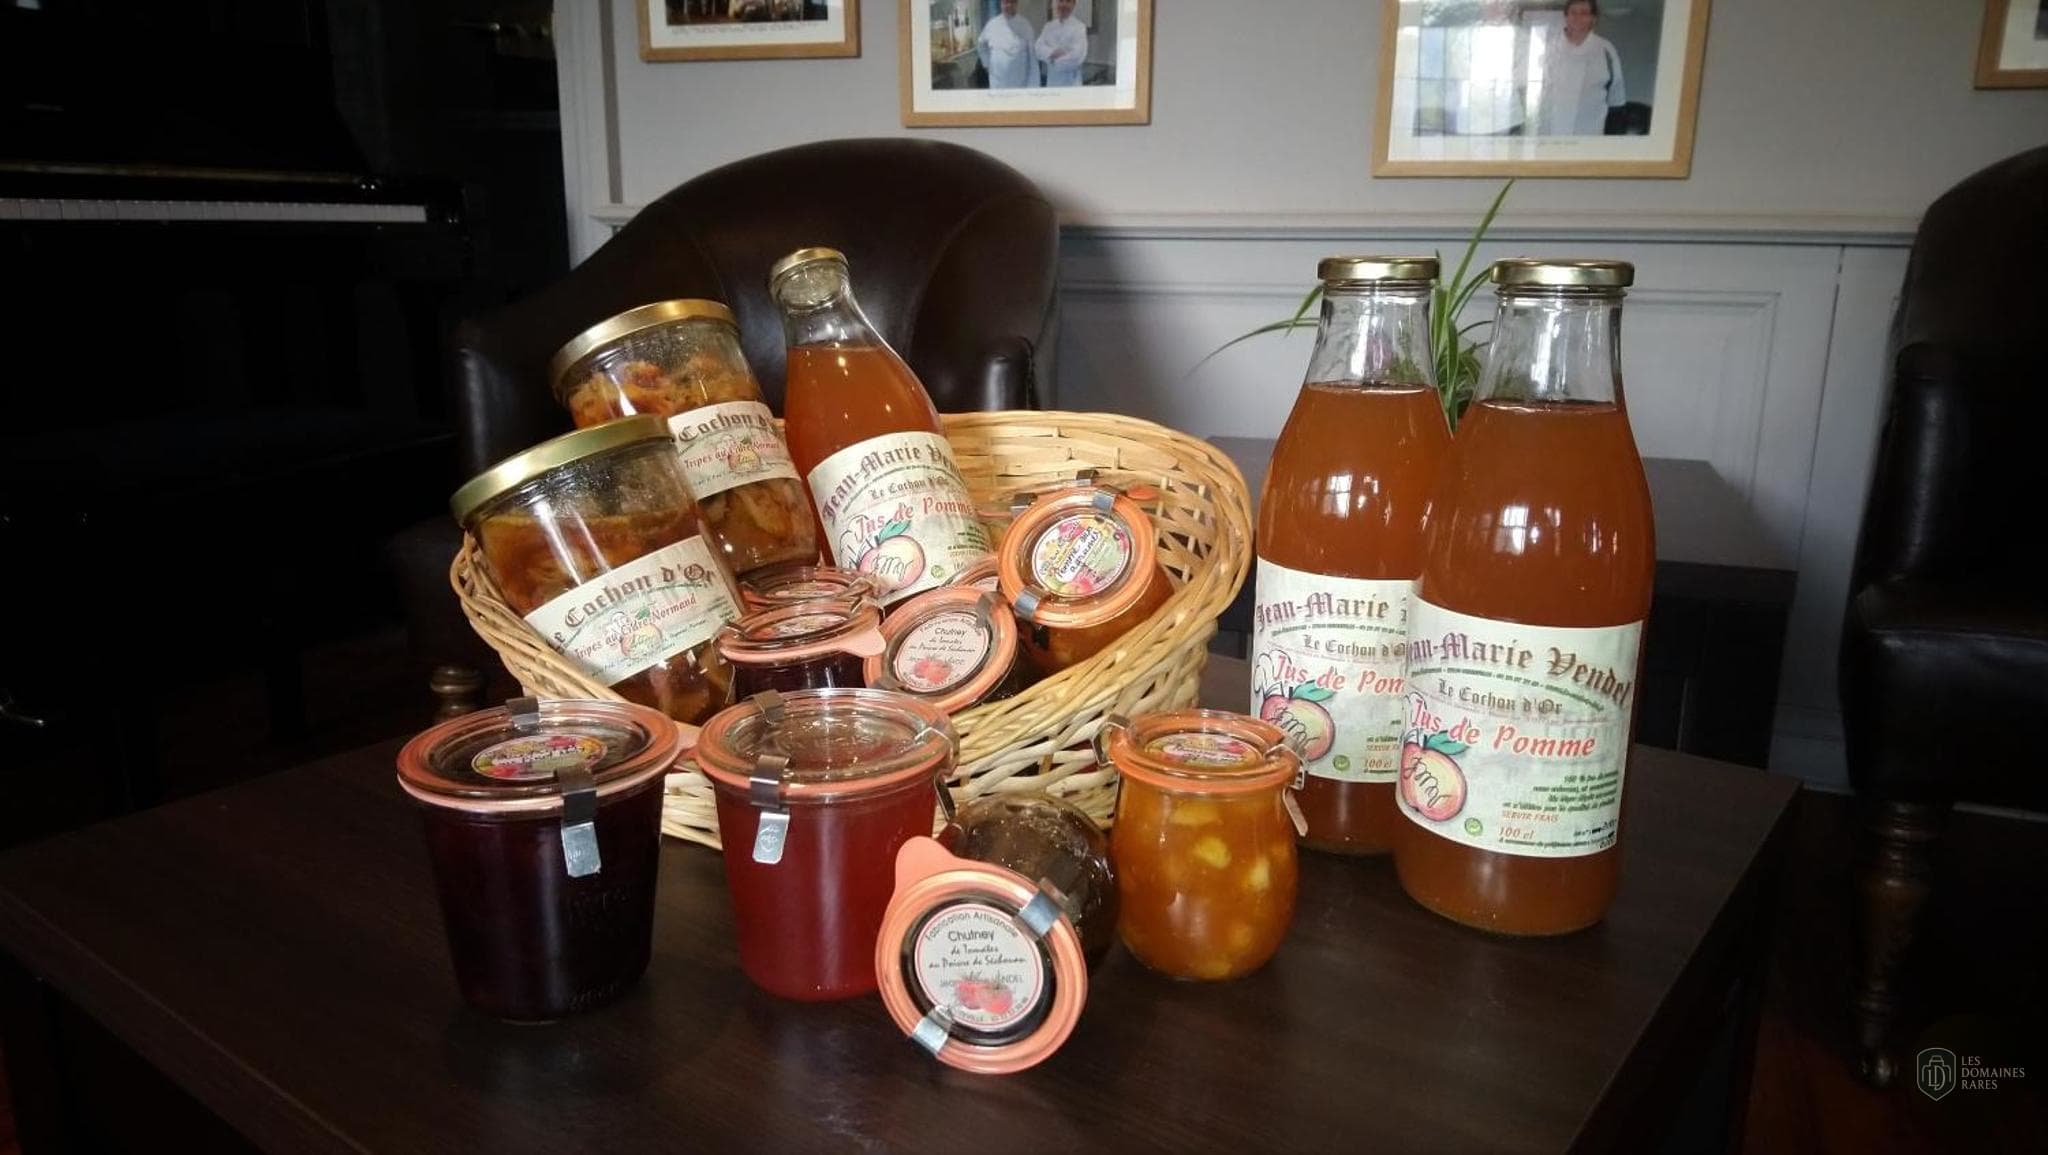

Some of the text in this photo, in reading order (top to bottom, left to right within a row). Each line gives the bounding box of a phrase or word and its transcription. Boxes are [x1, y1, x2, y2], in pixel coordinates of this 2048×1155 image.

[679, 413, 753, 441] Cochon
[822, 442, 922, 525] Jean-Marie
[870, 487, 885, 500] Le
[888, 477, 926, 494] Cochon
[855, 497, 974, 542] Jus de Pomme
[565, 575, 652, 628] Cochon
[661, 563, 715, 588] d'Or
[650, 593, 697, 625] Normand
[1256, 592, 1389, 634] Jean-Marie
[1303, 634, 1406, 657] Le Cochon d'O
[1274, 655, 1308, 684] Jus
[1317, 665, 1345, 690] de
[1408, 632, 1534, 668] an-Marie
[1548, 646, 1631, 709] Vendel
[1438, 678, 1563, 715] Le Cochon d'Or
[1411, 699, 1597, 758] Jus de Pomme
[1499, 826, 1521, 837] 100
[1523, 829, 1535, 840] cl
[948, 929, 995, 942] Chutney
